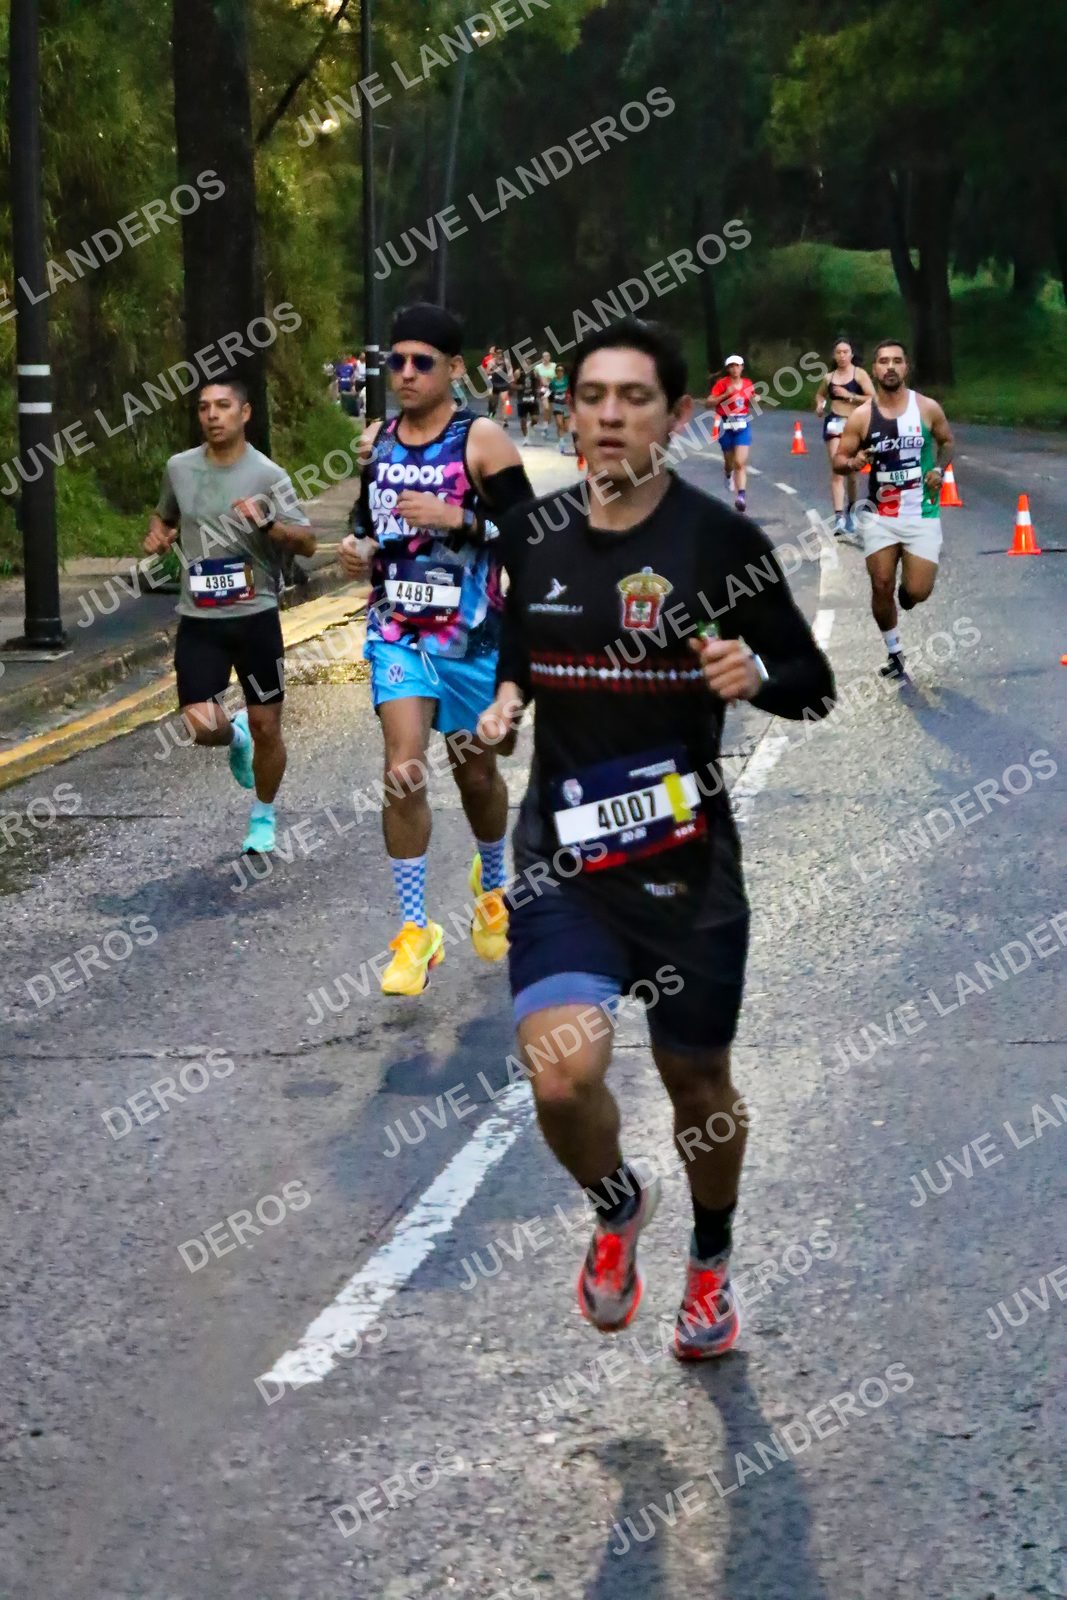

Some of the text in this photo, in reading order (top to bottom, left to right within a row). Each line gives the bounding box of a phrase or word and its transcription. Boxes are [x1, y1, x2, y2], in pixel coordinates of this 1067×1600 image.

[377, 462, 446, 485] TODOS
[205, 575, 234, 589] 4385
[396, 582, 434, 602] 4489
[597, 791, 656, 830] 4007
